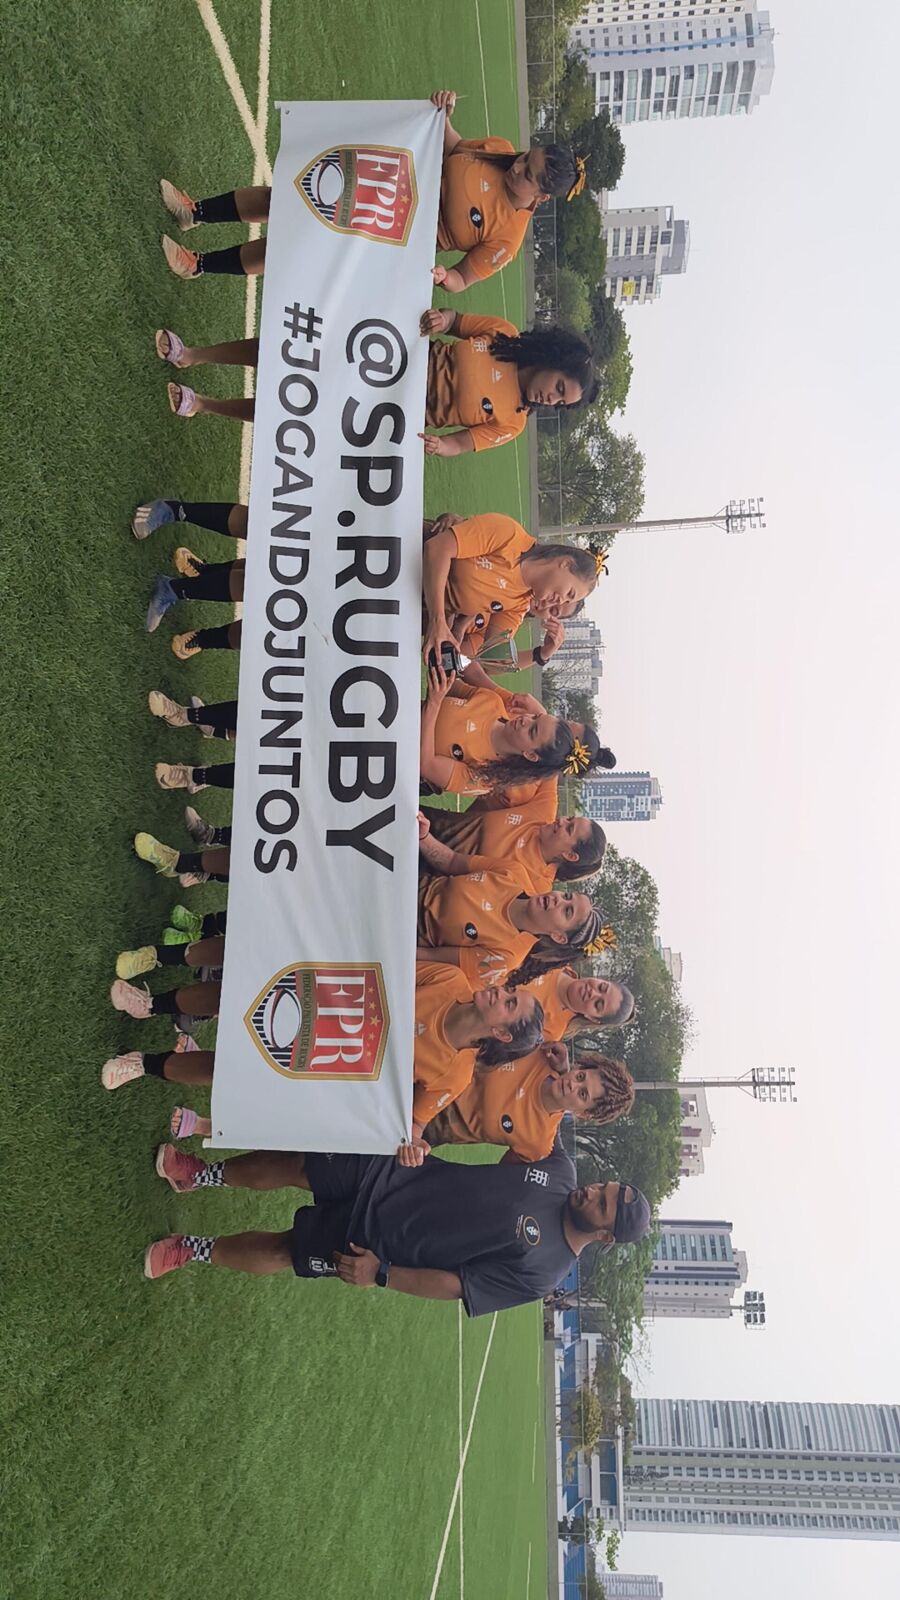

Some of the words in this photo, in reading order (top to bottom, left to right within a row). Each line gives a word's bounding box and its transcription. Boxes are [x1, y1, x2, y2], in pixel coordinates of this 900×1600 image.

[351, 149, 400, 228] FPR
[254, 302, 323, 874] #JOGANDOJUNTOS
[326, 319, 408, 872] @SP.RUGBY
[310, 971, 366, 1070] FPR
